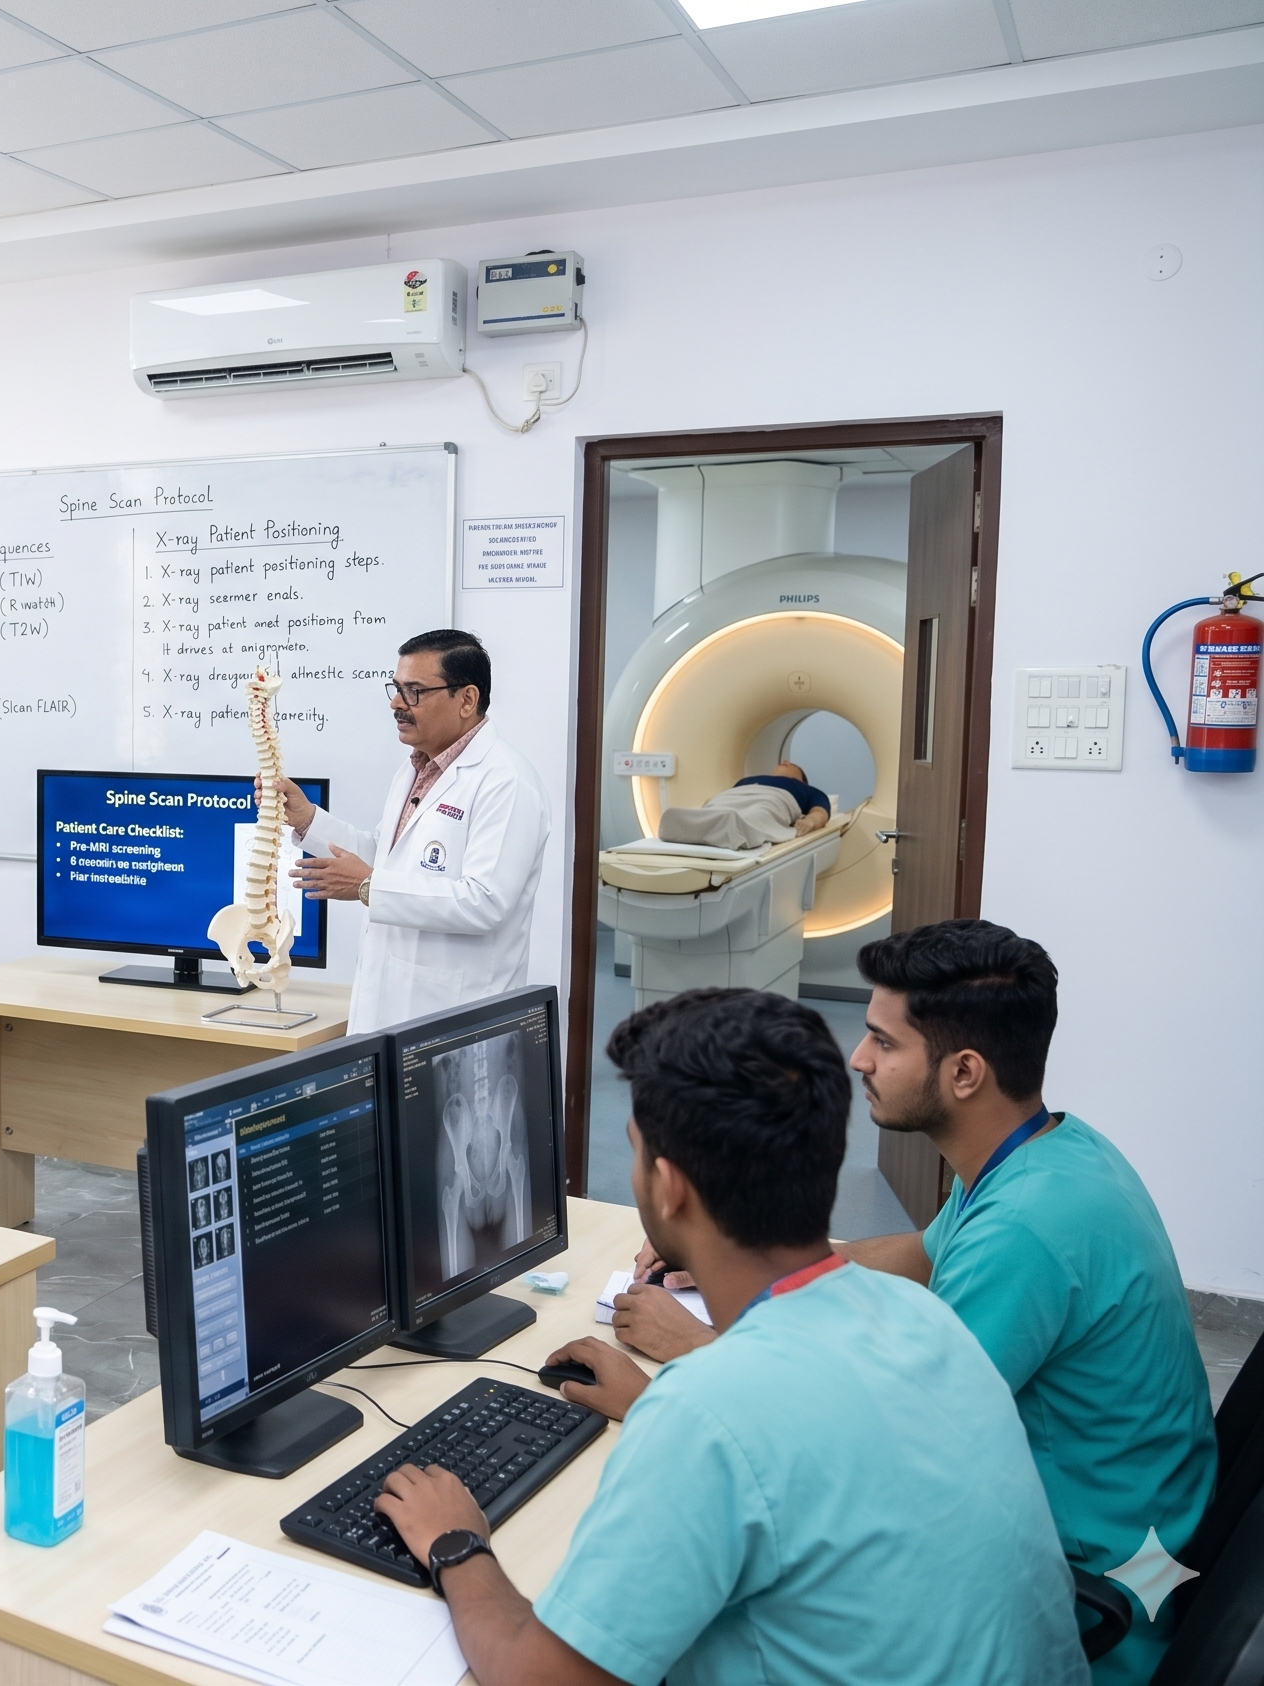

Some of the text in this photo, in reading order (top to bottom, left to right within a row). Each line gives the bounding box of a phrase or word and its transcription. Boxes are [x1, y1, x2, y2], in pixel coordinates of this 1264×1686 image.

[59, 484, 213, 521] Spine Scan Protocol
[156, 531, 198, 555] X-ray
[209, 523, 256, 544] Patient
[210, 558, 255, 584] patient
[263, 555, 336, 580] positioning
[344, 551, 384, 573] steps.
[143, 595, 155, 608] 2.
[779, 594, 820, 604] PHILIPS
[0, 618, 49, 640] (T2W)
[143, 621, 154, 634] 3.
[162, 619, 200, 640] X-ray
[208, 617, 247, 638] patient
[222, 643, 233, 654] at
[163, 668, 200, 690] X-ray
[143, 706, 155, 718] 5.
[162, 704, 201, 729] X-ray
[106, 790, 251, 810] Spine Scan Protocol
[56, 821, 184, 838] Patient Care Checklist:
[70, 840, 161, 858] Pre-MRI screening
